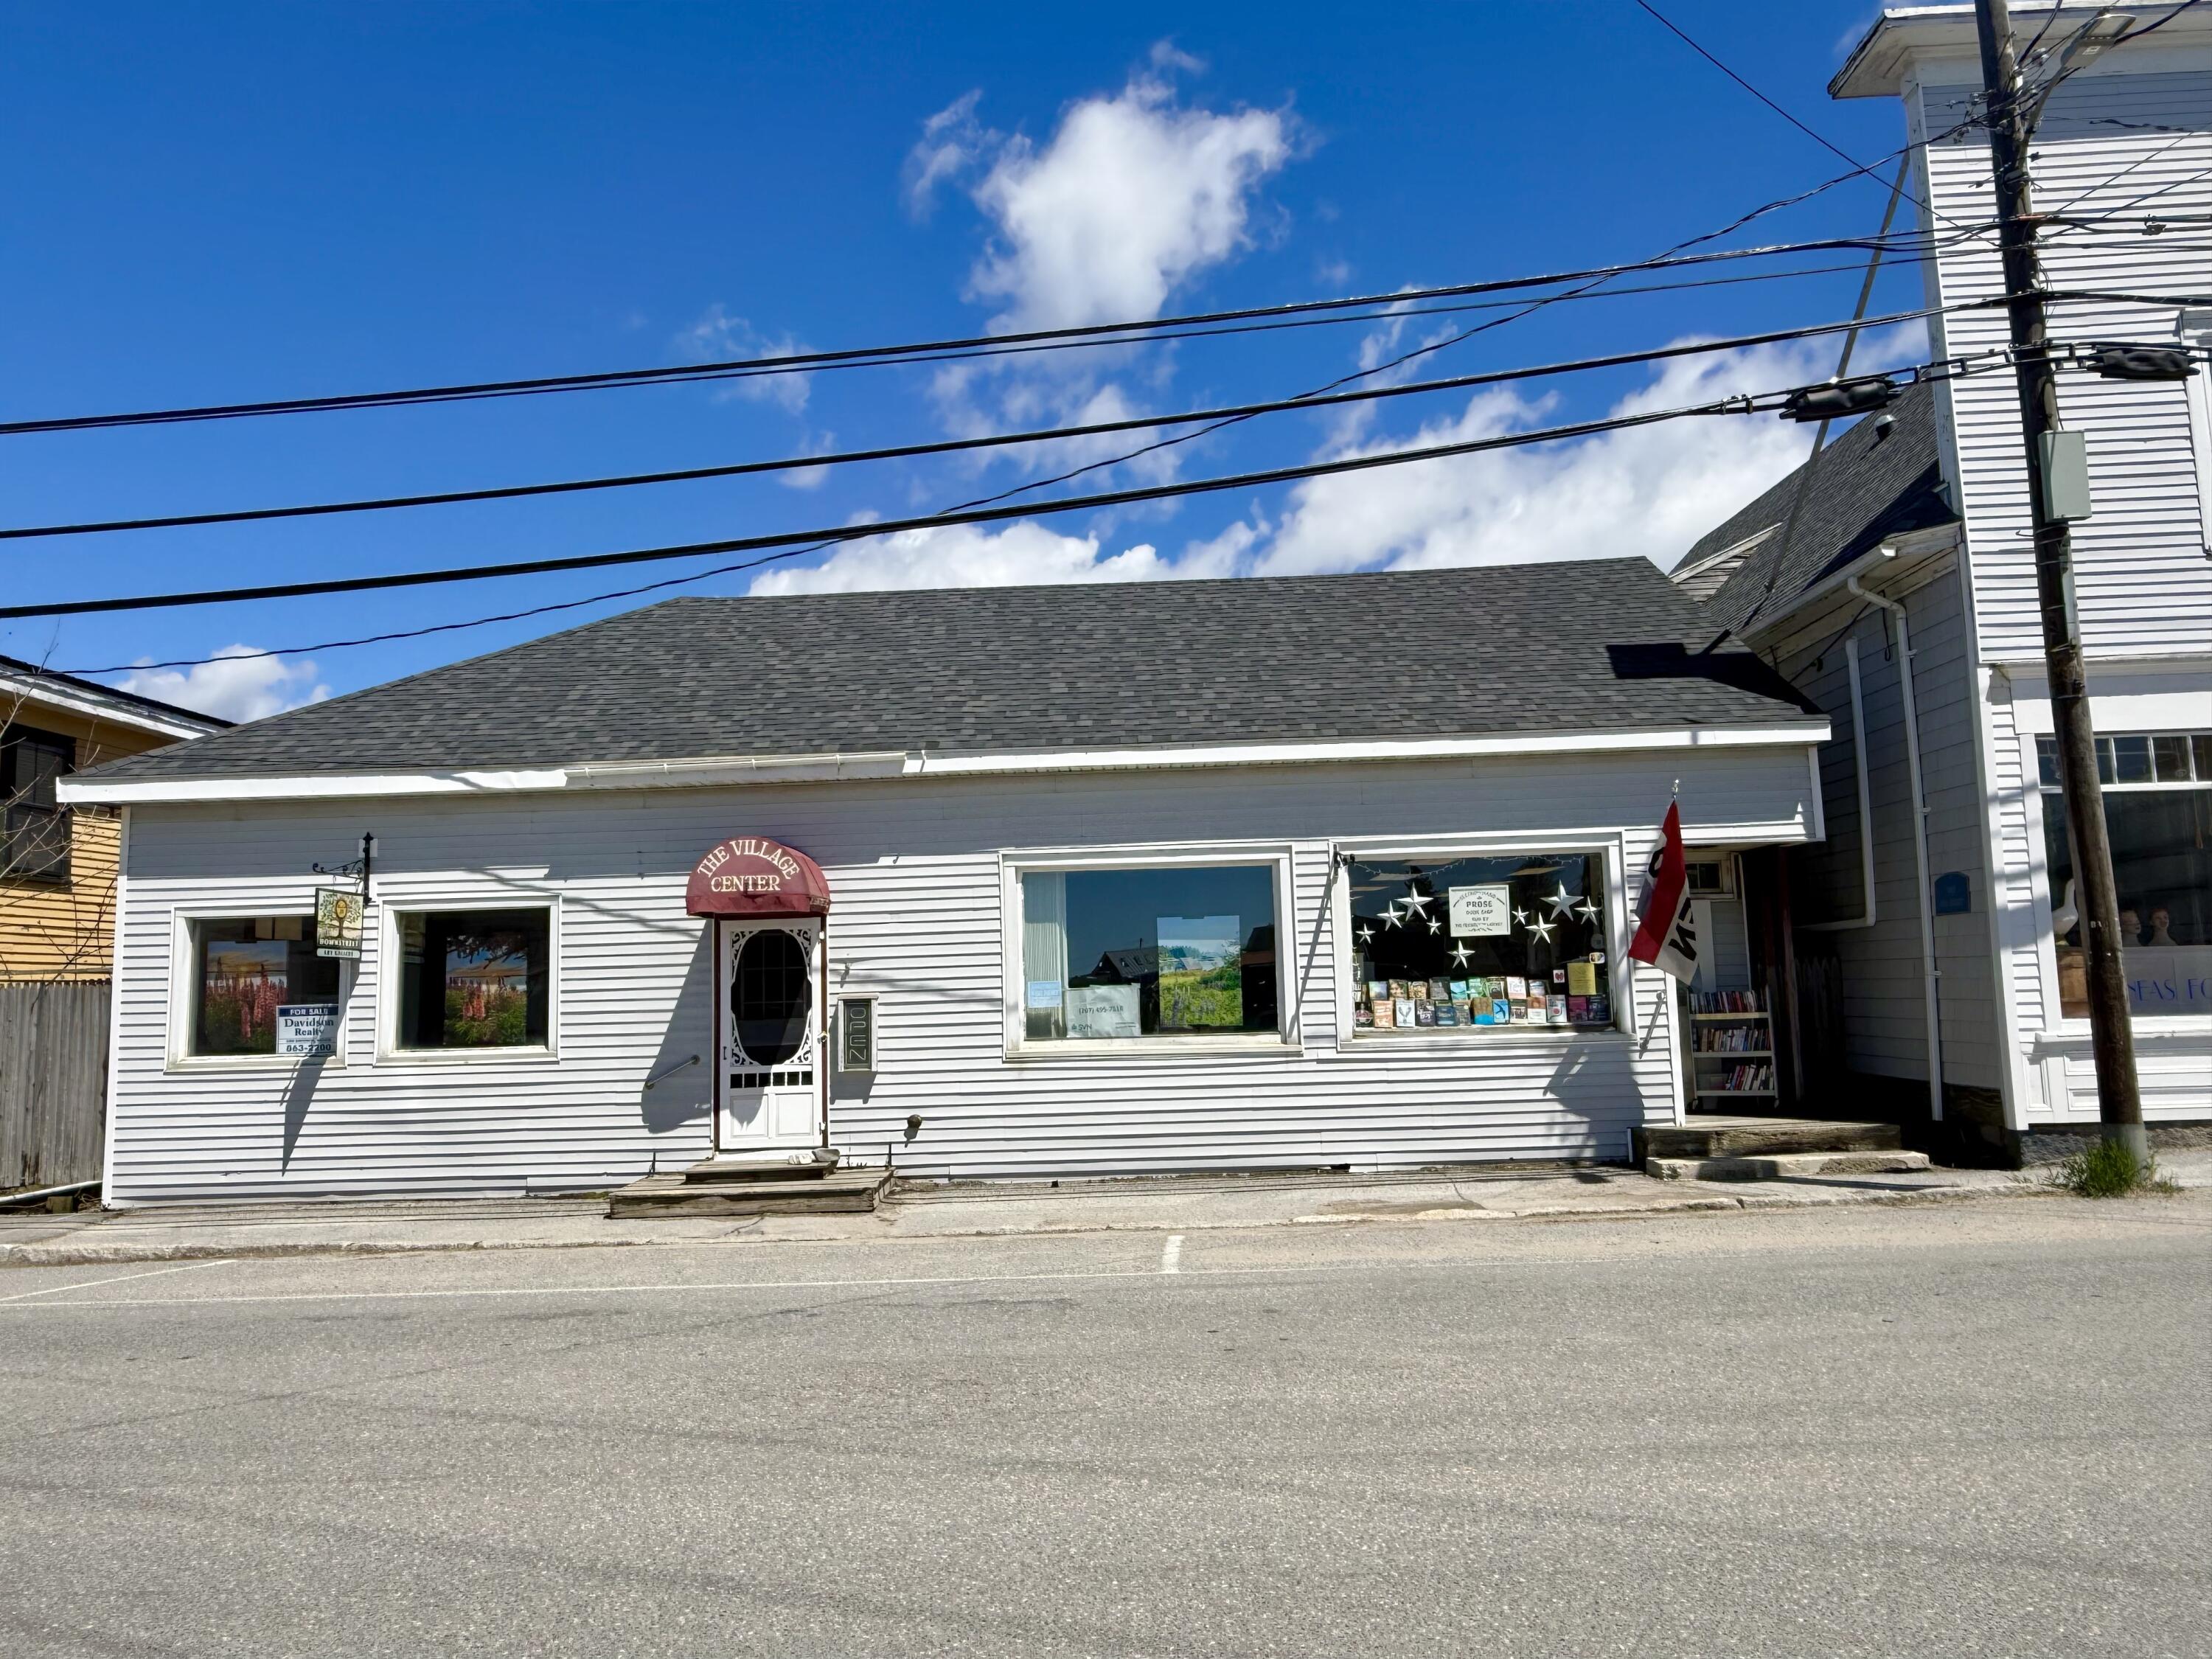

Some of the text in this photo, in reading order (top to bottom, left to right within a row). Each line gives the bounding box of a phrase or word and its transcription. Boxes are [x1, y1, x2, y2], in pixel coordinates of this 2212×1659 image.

[697, 839, 801, 880] THE VILLAGE
[710, 874, 782, 892] CENTER
[284, 1017, 335, 1028] Davidson
[295, 1027, 324, 1037] Realty
[849, 1007, 866, 1061] OPEN
